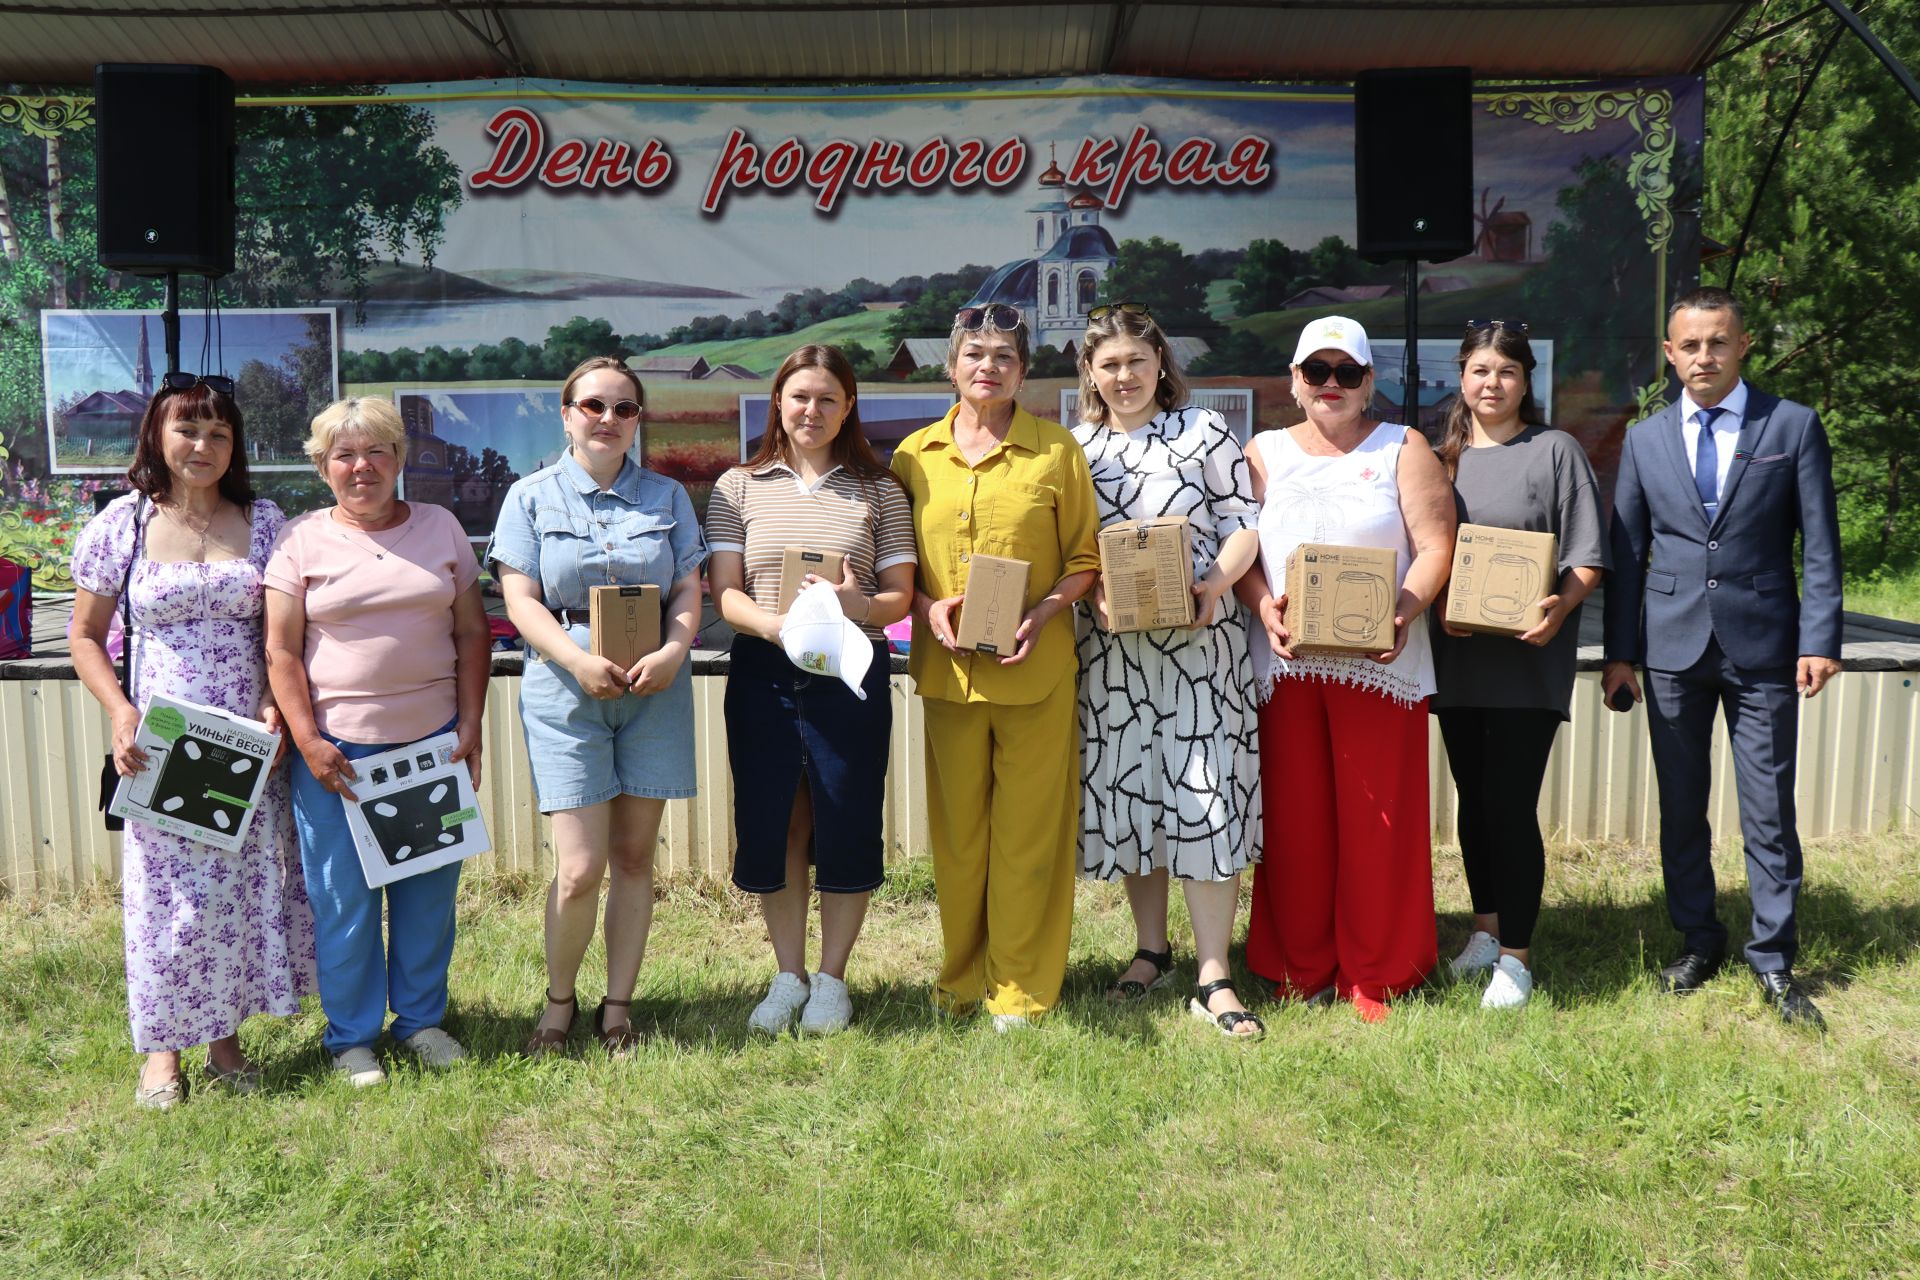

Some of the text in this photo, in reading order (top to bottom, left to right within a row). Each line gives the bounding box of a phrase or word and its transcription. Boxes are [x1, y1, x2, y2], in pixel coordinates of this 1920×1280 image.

[469, 106, 1270, 213] День родного края
[188, 722, 271, 757] УМНЫЕ ВЕСЫ
[226, 728, 273, 747] НАПОЛЬНЫЕ
